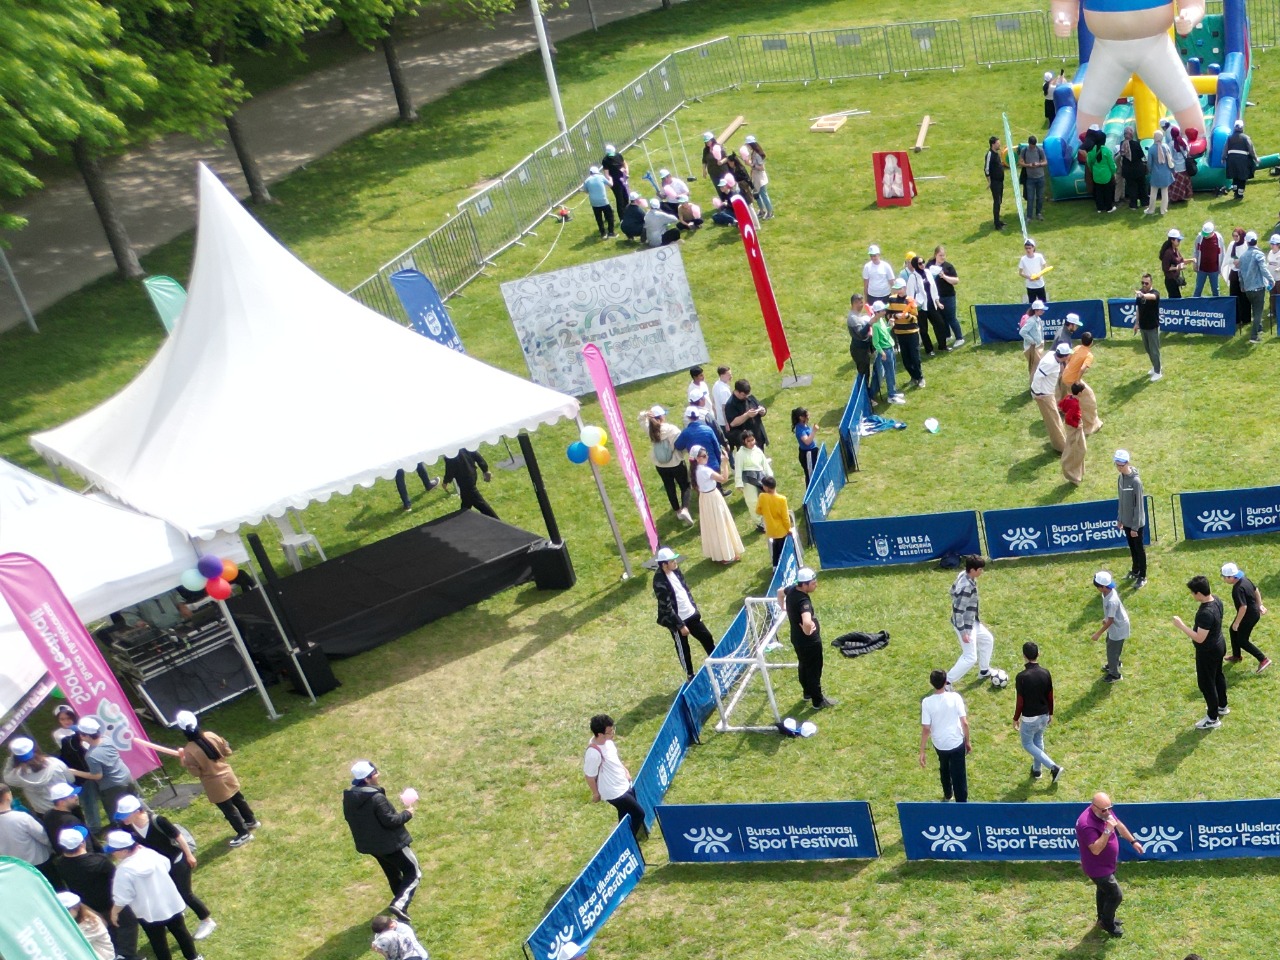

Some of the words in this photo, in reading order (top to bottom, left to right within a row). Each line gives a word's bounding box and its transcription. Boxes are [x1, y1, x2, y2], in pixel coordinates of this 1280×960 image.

[1159, 315, 1183, 326] Spor
[1184, 317, 1226, 328] Festivali
[1246, 507, 1273, 515] Bursa
[1247, 515, 1277, 527] Spor
[1052, 524, 1078, 533] Bursa
[897, 534, 931, 544] BURSA
[1052, 533, 1083, 546] Spor
[745, 826, 780, 836] Bursa
[783, 825, 852, 835] Uluslararası
[985, 825, 1020, 836] Bursa
[1198, 824, 1232, 834] Bursa
[748, 836, 787, 852] Spor
[790, 834, 859, 849] Festivali
[987, 836, 1025, 852] Spor
[1198, 834, 1238, 850] Spor
[582, 899, 604, 930] Spor
[602, 854, 639, 905] Festivali
